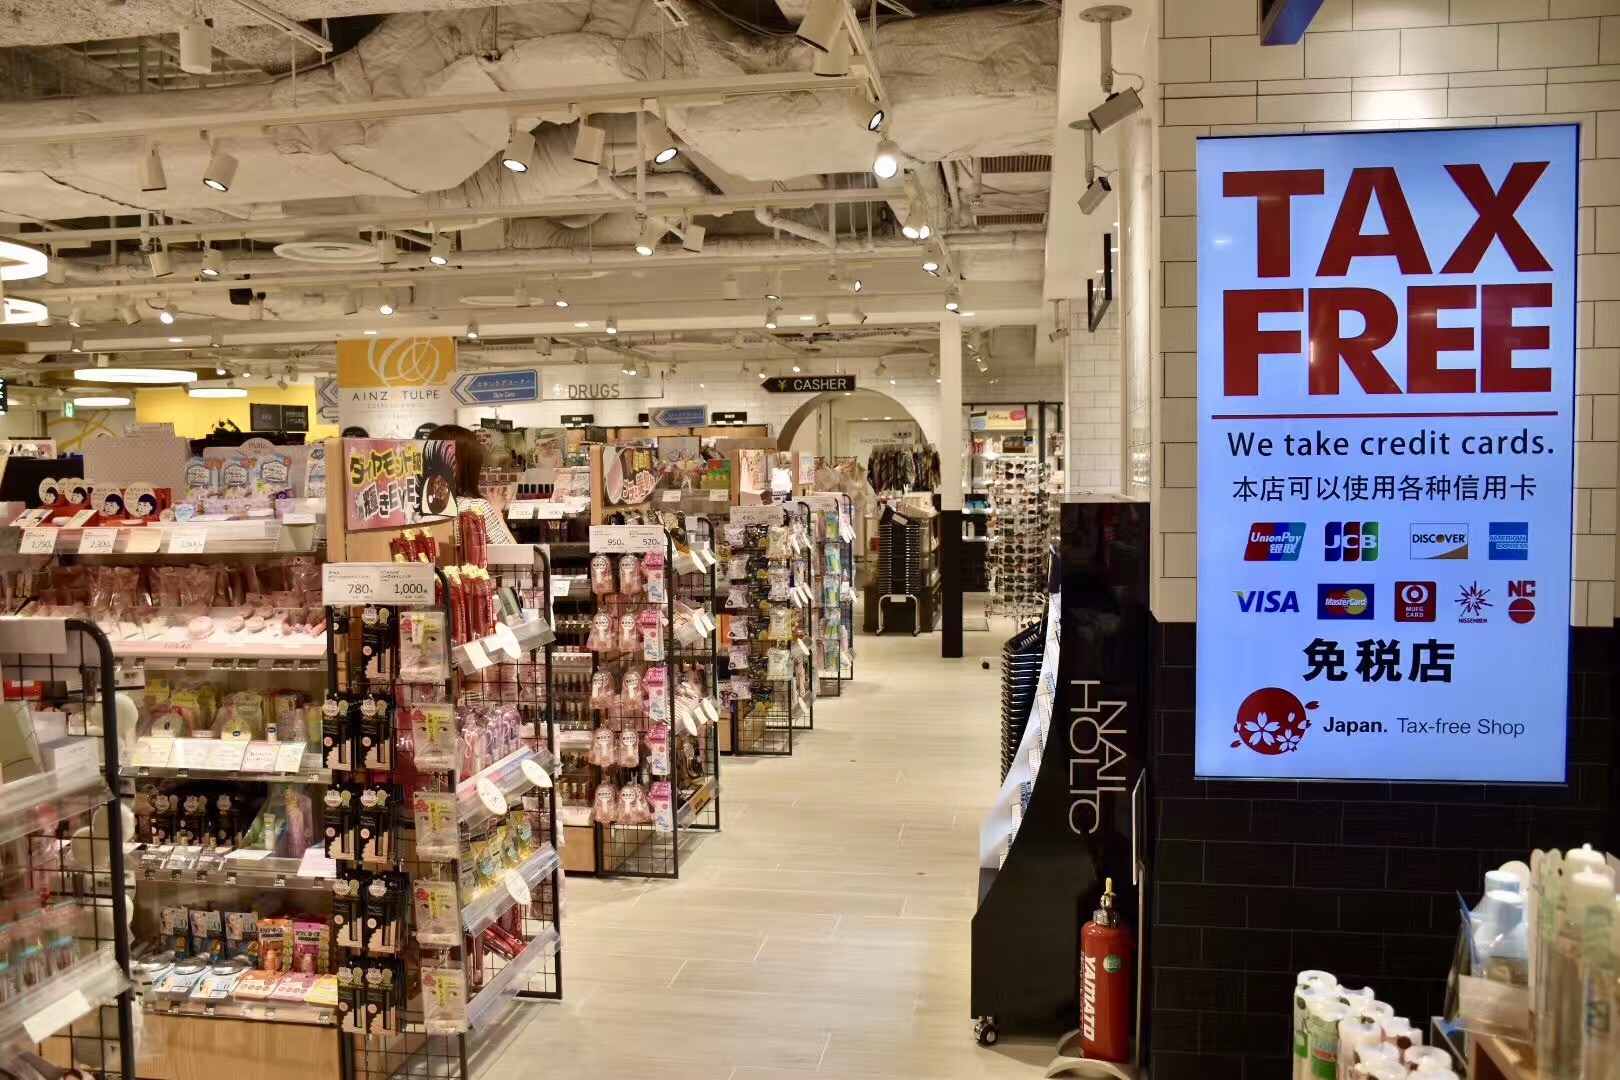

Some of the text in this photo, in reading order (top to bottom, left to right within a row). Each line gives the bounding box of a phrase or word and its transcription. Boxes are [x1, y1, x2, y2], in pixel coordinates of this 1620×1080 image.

[1222, 161, 1554, 278] TAX
[1223, 283, 1553, 396] FREE
[352, 389, 440, 401] AINZ TULPE
[568, 384, 620, 398] DRUGS
[793, 379, 847, 391] CASHER
[1227, 428, 1554, 456] We take credit cards.
[1232, 475, 1537, 501] 本店可以使用各种信用卡
[1251, 532, 1302, 545] UnionPay
[1269, 543, 1297, 554] 银联
[1412, 534, 1466, 544] DISCOVER
[1489, 534, 1527, 542] AMERICAN
[1508, 581, 1536, 598] NC
[1232, 591, 1300, 613] VISA
[1325, 597, 1367, 607] MasterCard
[1302, 638, 1455, 683] 免税店
[1323, 717, 1525, 738] Japan. Tax-free Shop
[1069, 680, 1100, 834] HOLIC
[1096, 701, 1128, 803] NAIL
[1083, 955, 1096, 1042] YAMATO
